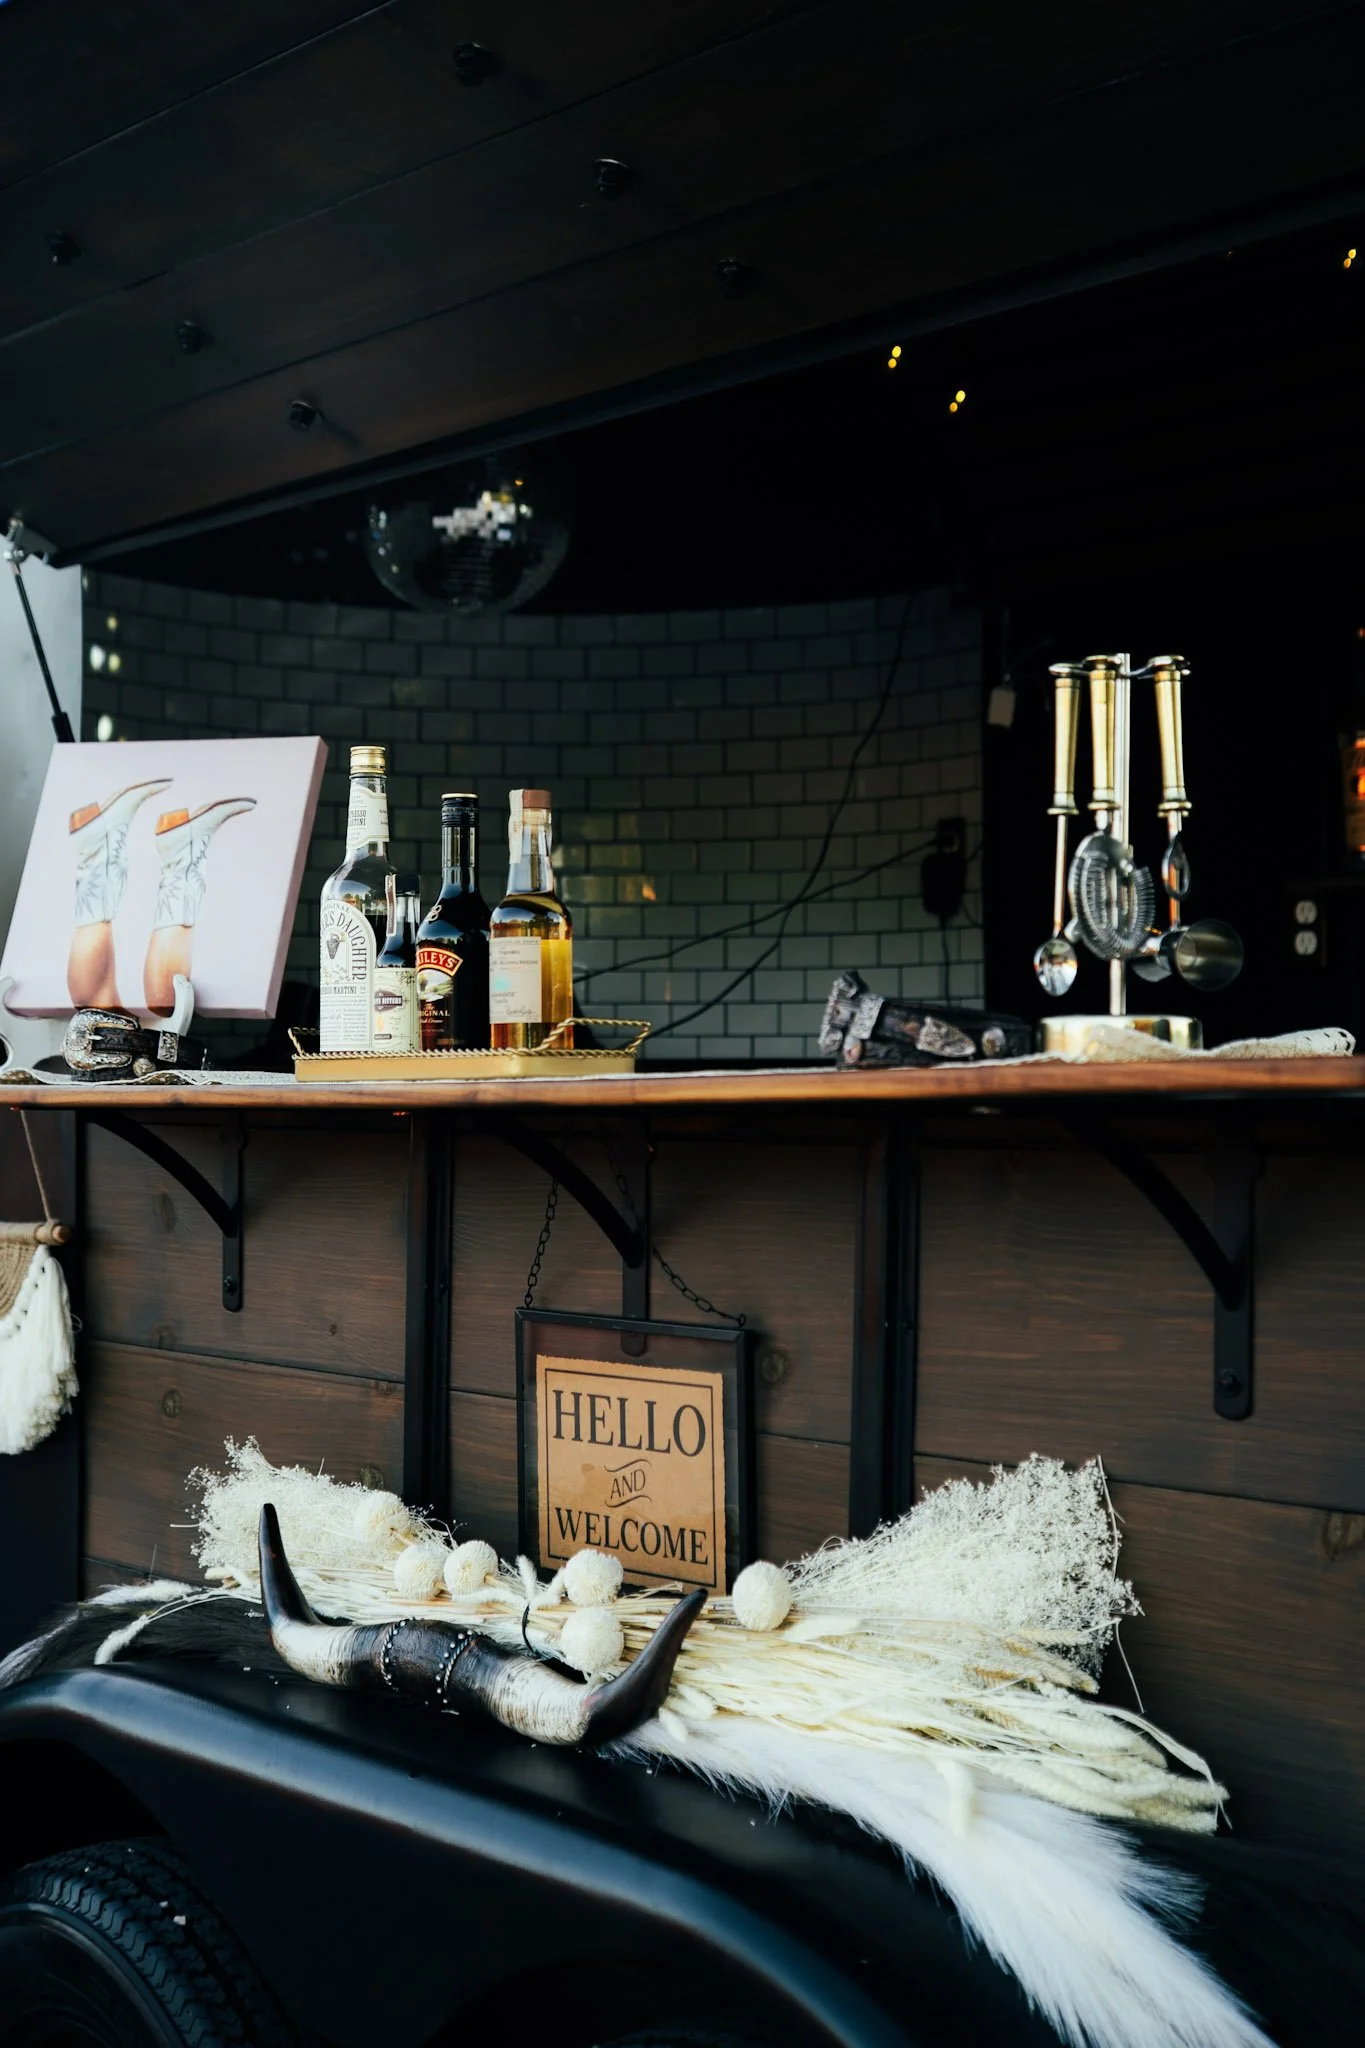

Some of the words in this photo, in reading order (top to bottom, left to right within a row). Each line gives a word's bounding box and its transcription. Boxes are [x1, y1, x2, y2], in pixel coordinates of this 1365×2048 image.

[336, 912, 367, 981] DAUGHTER
[333, 986, 357, 995] MARTINI
[552, 1389, 706, 1458] HELLO
[610, 1469, 646, 1500] AND
[554, 1507, 709, 1566] WELCOME
